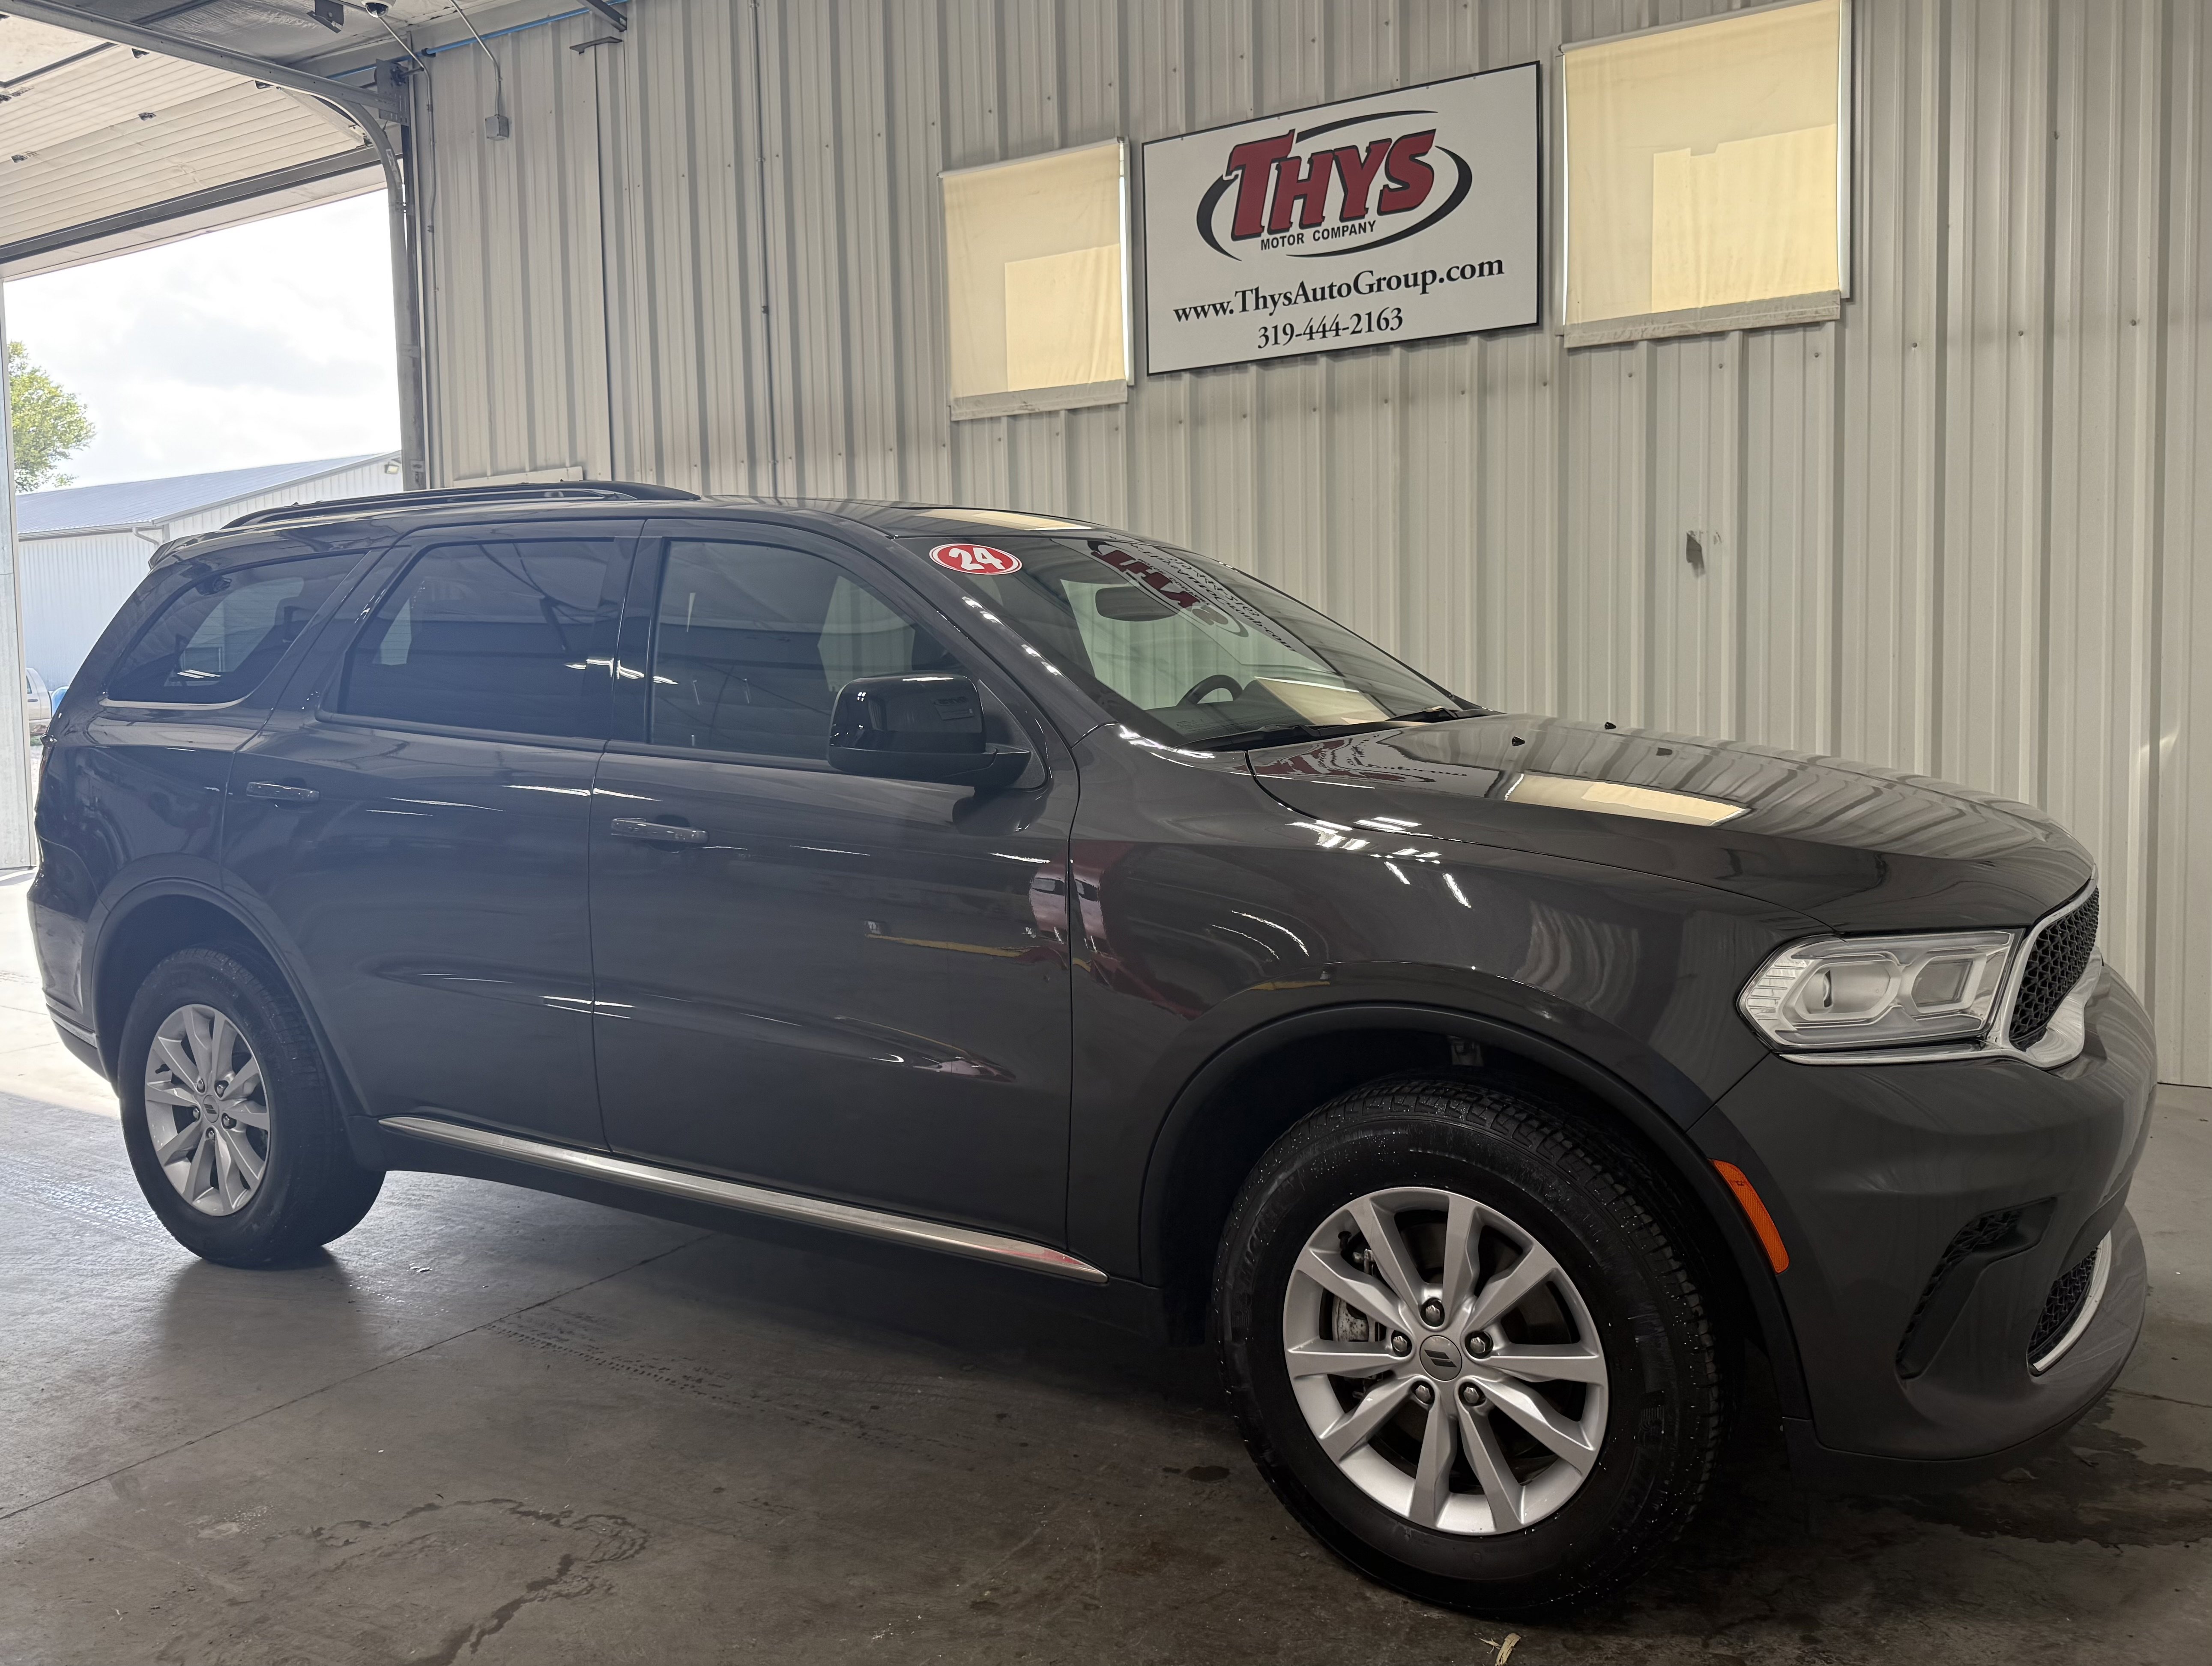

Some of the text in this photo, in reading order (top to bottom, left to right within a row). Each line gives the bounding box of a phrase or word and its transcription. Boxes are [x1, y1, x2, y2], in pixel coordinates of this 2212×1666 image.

[1225, 128, 1436, 241] THYS
[1261, 220, 1376, 251] MOTOR COMPANY
[1173, 258, 1504, 322] www.ThysAutoGroup.com
[1257, 307, 1403, 349] 319-444-2163
[948, 547, 1006, 570] 24
